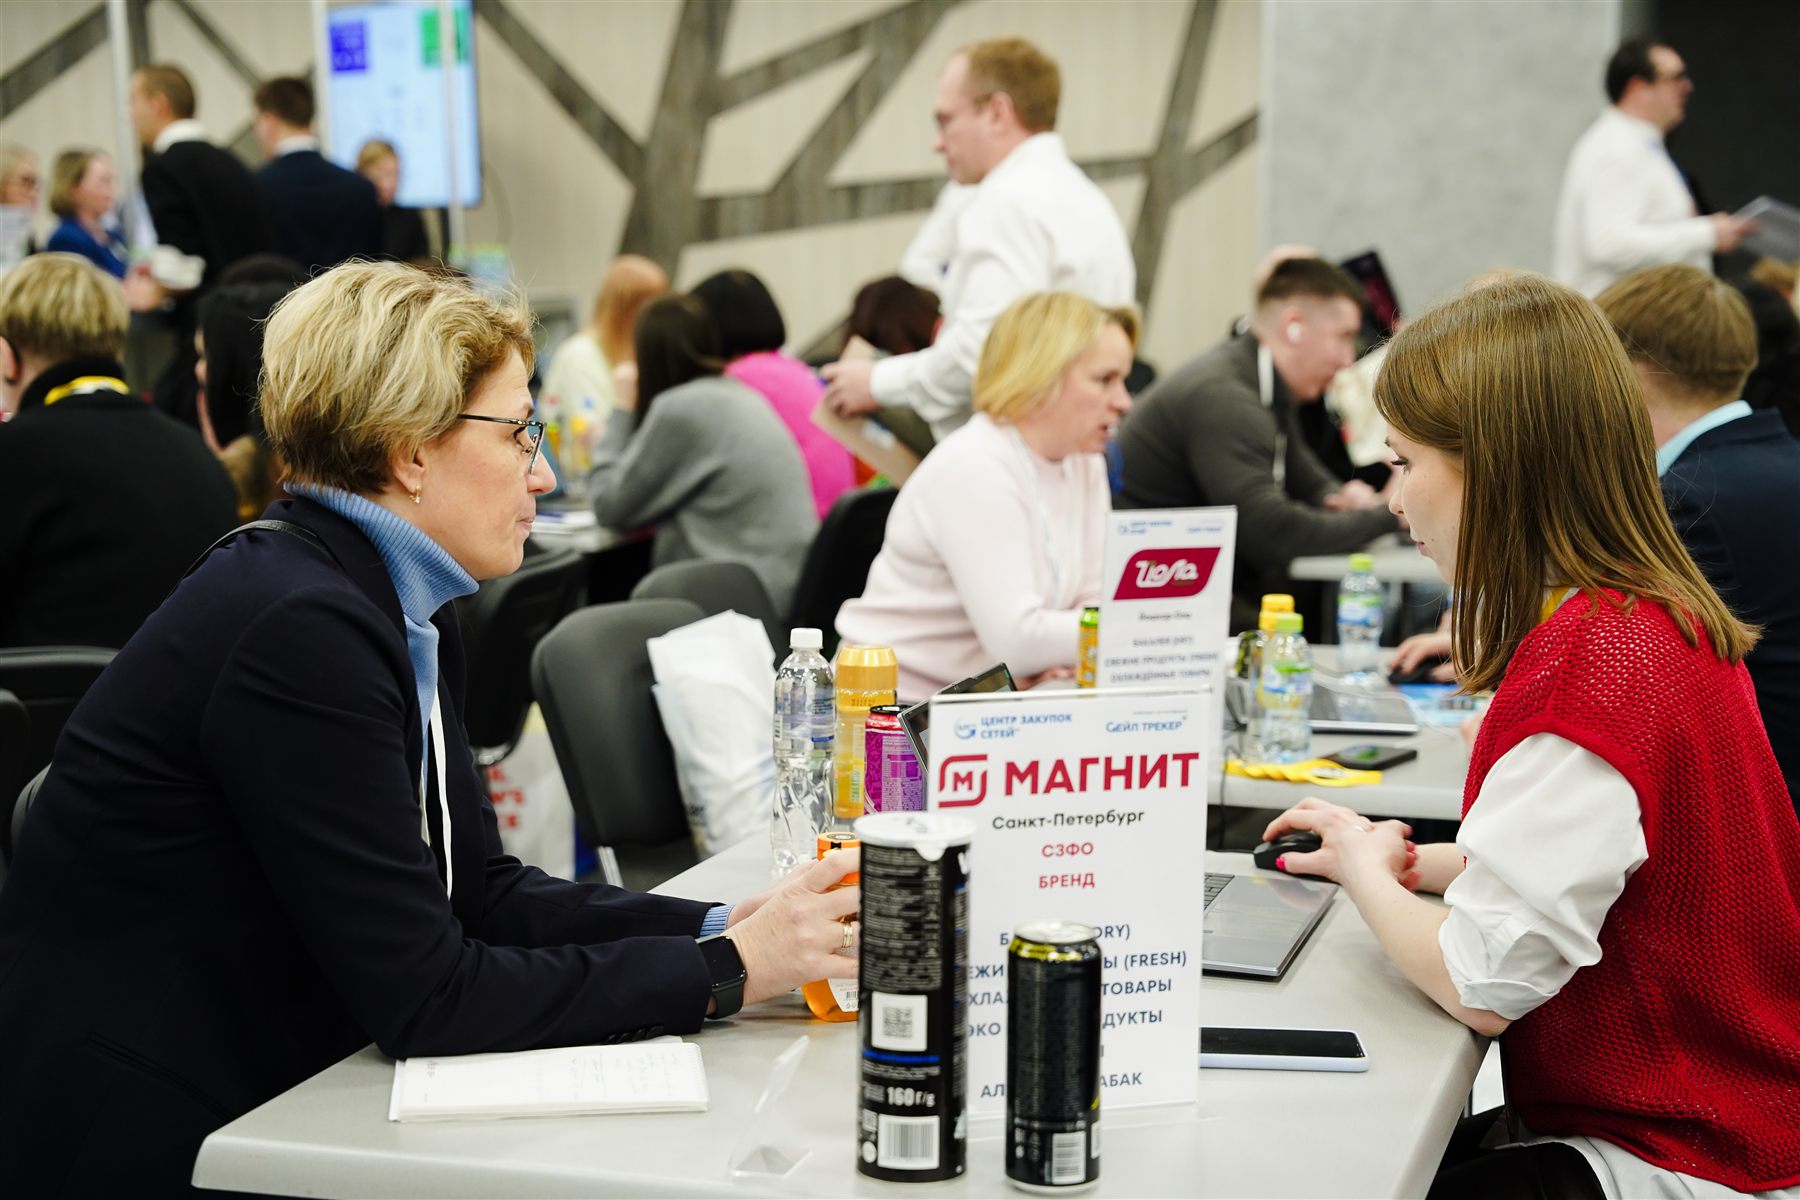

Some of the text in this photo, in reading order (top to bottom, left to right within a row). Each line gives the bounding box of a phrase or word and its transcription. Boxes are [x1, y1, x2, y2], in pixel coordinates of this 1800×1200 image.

[981, 714, 1073, 726] ЦЕНТР ЗАКУПОК
[1142, 720, 1182, 731] ТРЕКЕР
[981, 727, 1014, 739] СЕТЕЙ
[1004, 752, 1200, 796] МАГНИТ
[992, 810, 1145, 830] Санкт-Петербург
[1041, 842, 1094, 858] СЗФО
[1039, 873, 1096, 889] БРЕНД
[1124, 950, 1187, 971] (FRESH)
[1102, 1010, 1162, 1029] ДУКТЫ
[1100, 1073, 1142, 1088] АБАК
